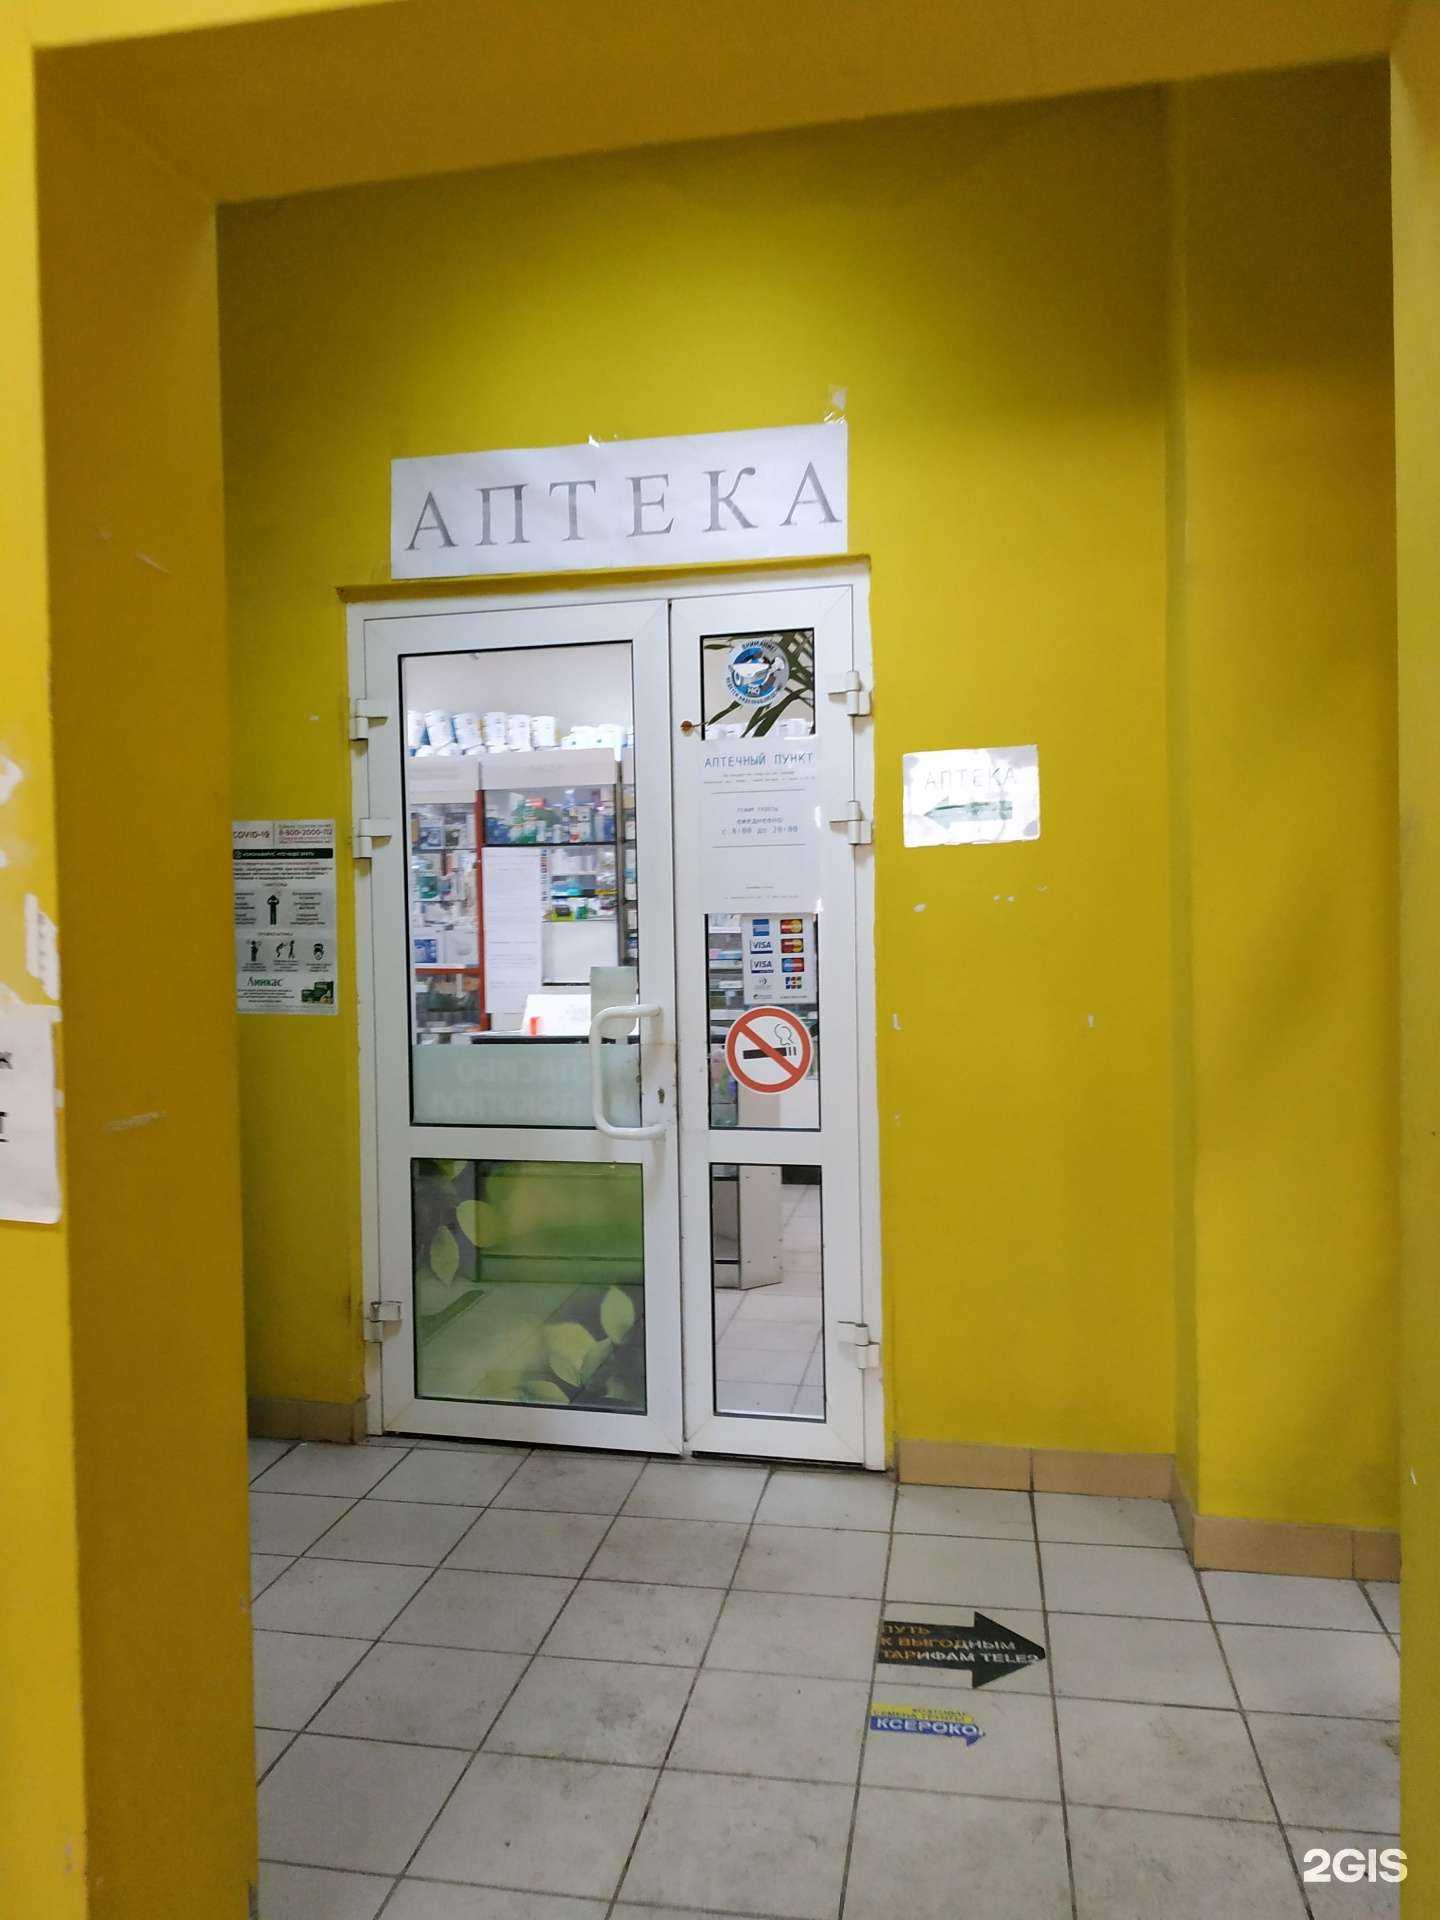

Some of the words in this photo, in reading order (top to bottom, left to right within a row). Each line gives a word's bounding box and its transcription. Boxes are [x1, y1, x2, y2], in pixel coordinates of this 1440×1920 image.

[404, 460, 843, 551] АПТЕКА
[704, 753, 766, 769] АПТЕЧНЫЙ
[774, 752, 814, 765] ПУНКТ
[924, 766, 1017, 791] АПТЕКА
[753, 941, 771, 949] VISA
[754, 960, 772, 968] VISA
[881, 1624, 930, 1634] ПУТЬ
[880, 1636, 892, 1646] К
[898, 1636, 1016, 1650] ВЫГОДНЫМ
[882, 1650, 975, 1662] ТАРИФАМ
